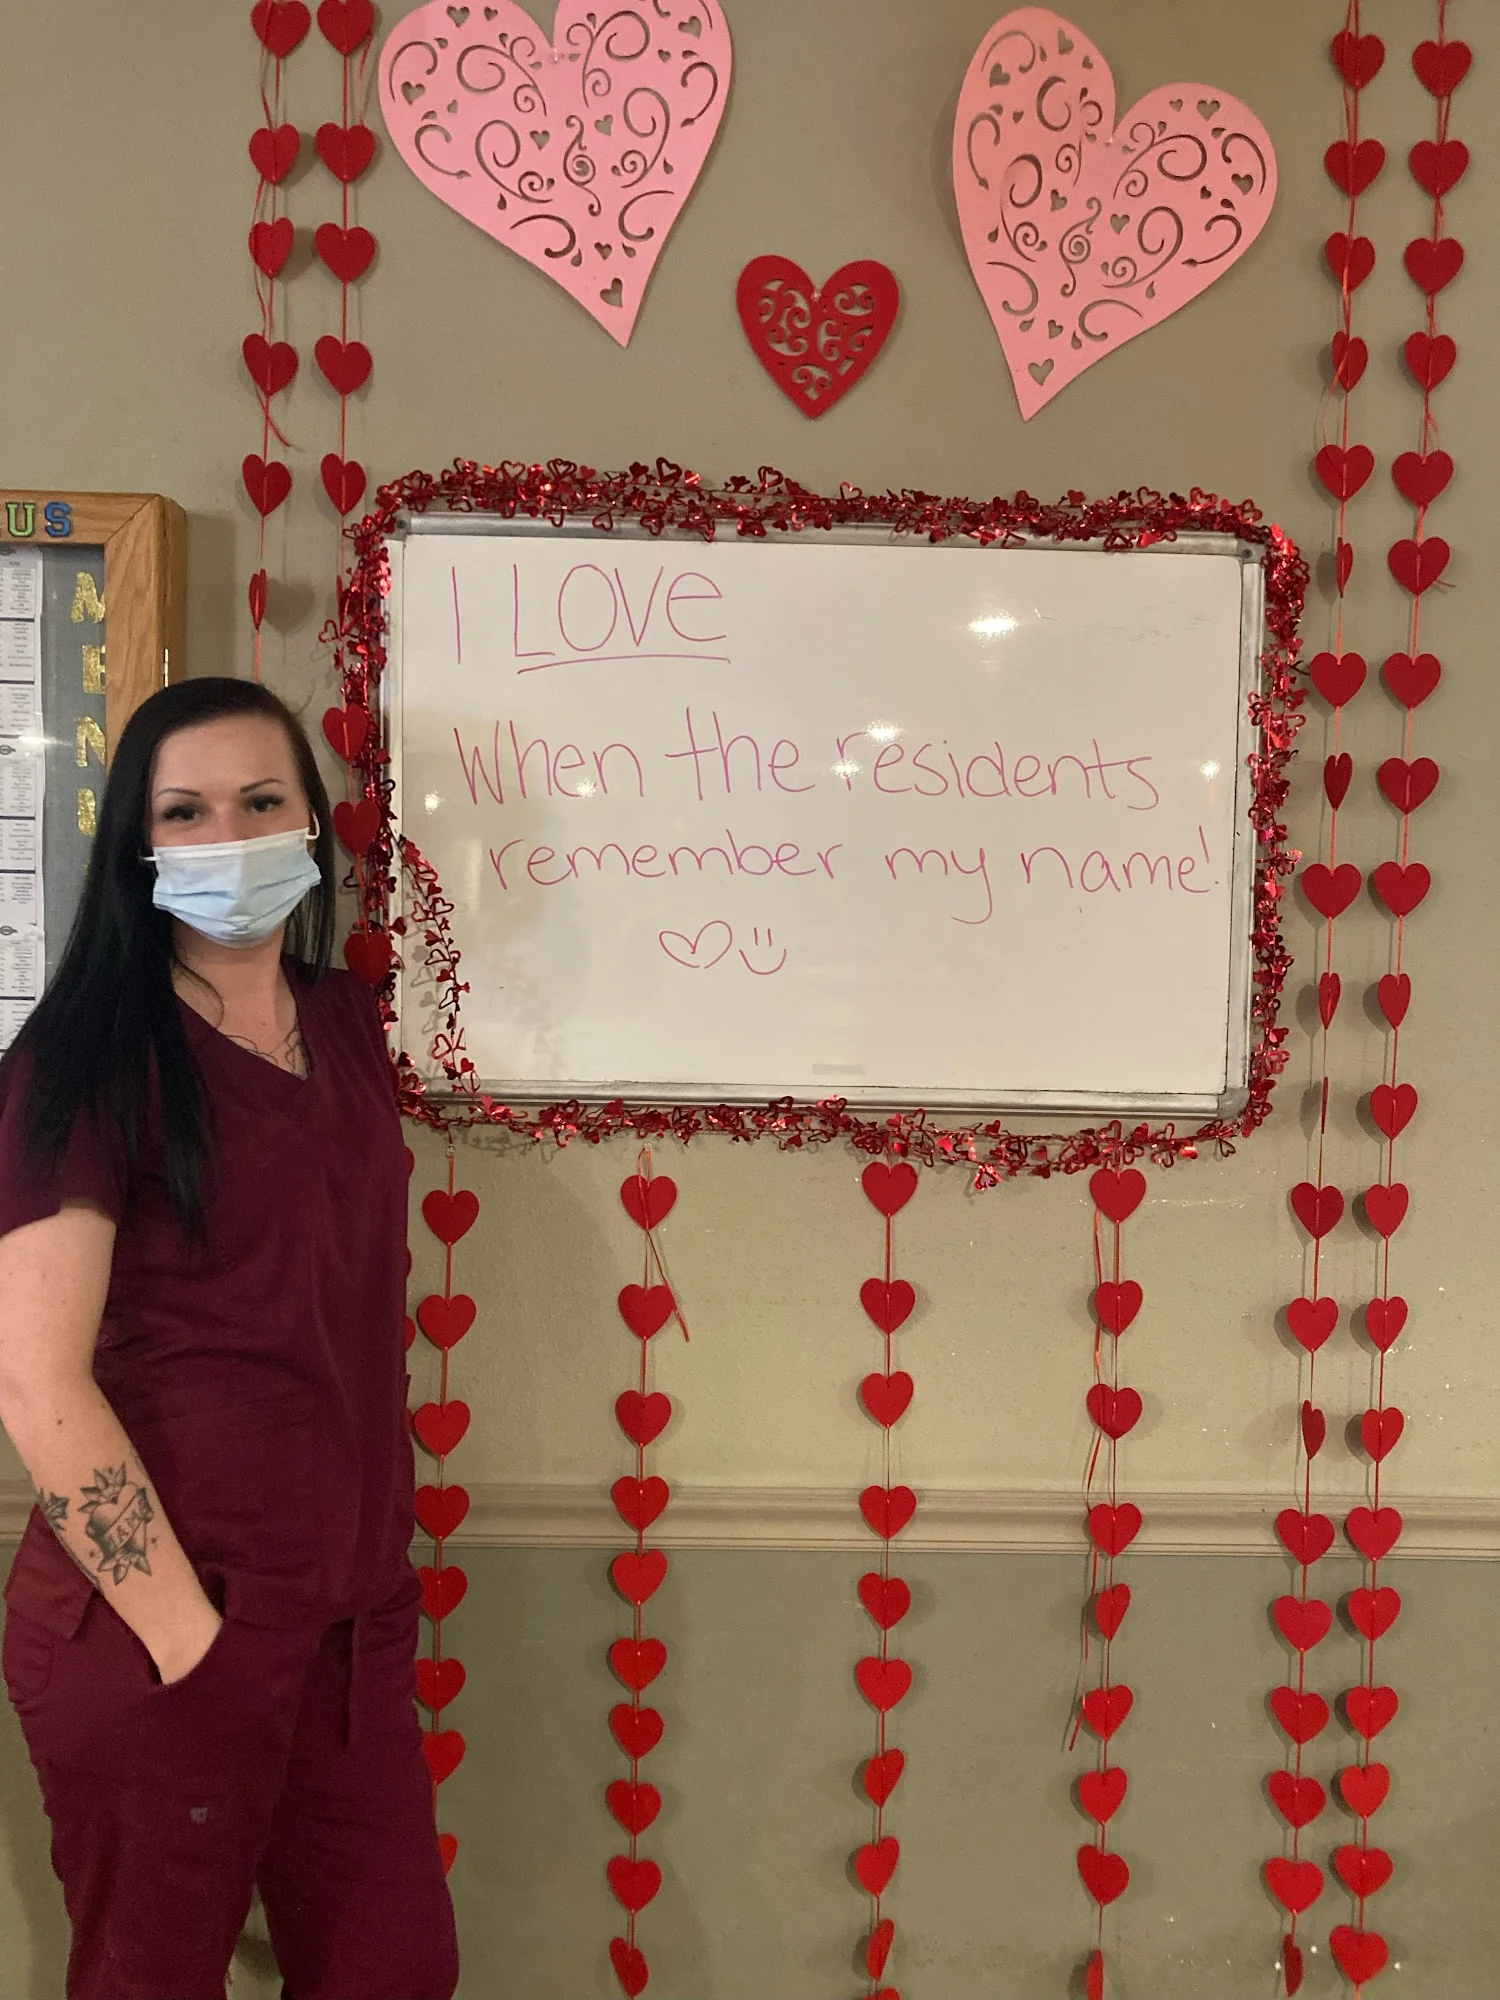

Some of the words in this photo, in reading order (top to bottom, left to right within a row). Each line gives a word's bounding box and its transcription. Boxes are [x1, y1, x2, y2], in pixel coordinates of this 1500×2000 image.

[451, 565, 462, 665] I
[453, 719, 645, 805] When
[664, 706, 816, 801] the
[836, 731, 1160, 811] residents
[489, 828, 844, 891] remember
[884, 846, 994, 925] my
[1019, 824, 1221, 893] name!
